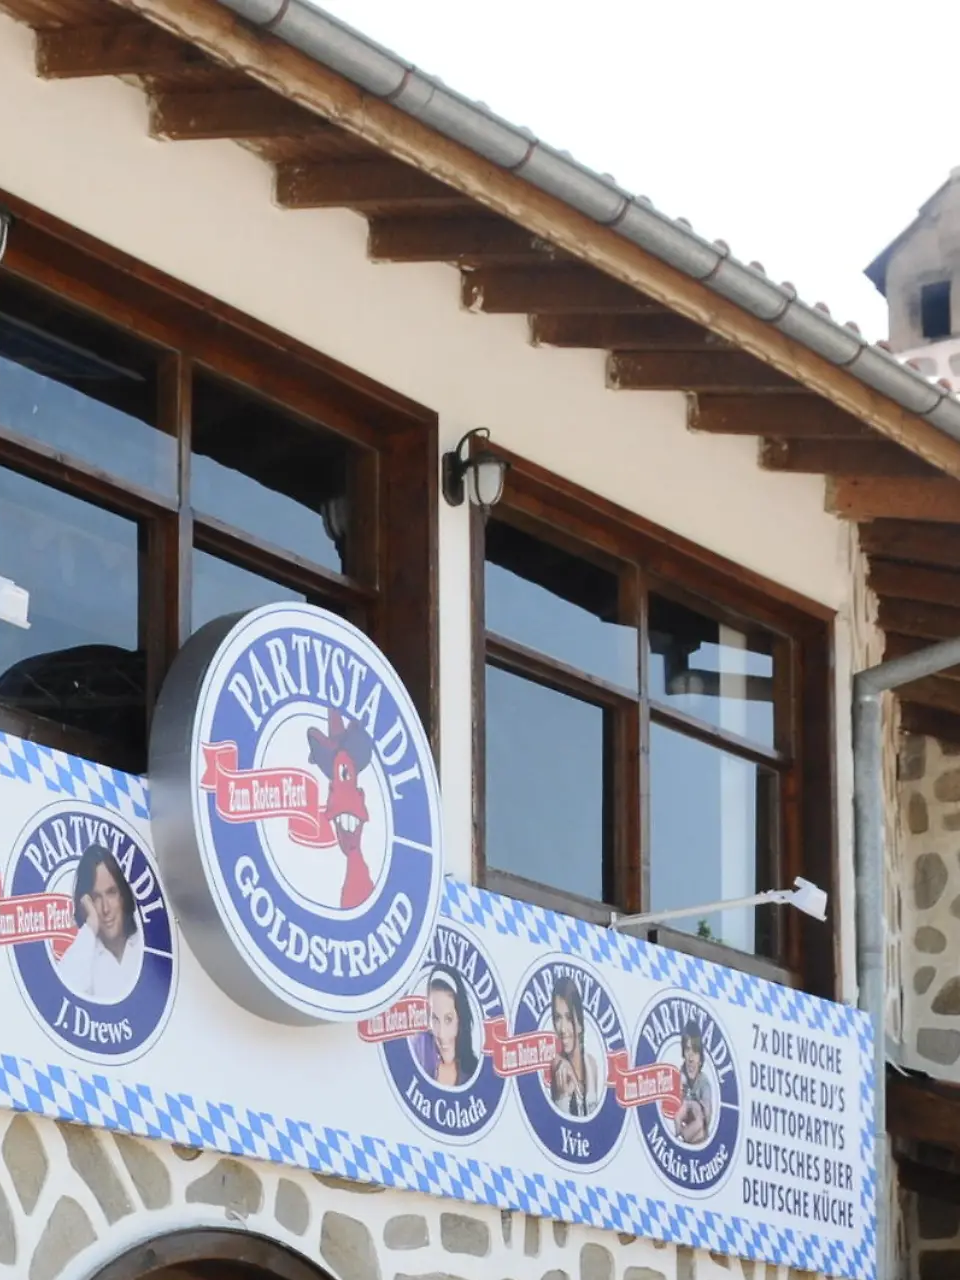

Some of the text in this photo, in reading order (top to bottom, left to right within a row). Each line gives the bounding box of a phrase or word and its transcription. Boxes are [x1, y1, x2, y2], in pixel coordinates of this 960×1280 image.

[227, 633, 423, 800] PARTYSTADL
[228, 774, 307, 810] Zum Roten Pferd
[16, 905, 46, 934] Roten
[46, 901, 70, 930] Pferd
[234, 855, 413, 978] GOLDSTRAND
[54, 997, 132, 1042] J. Drews
[752, 1023, 842, 1074] 7x DIE WOCHE
[405, 1075, 487, 1129] Ina Colada
[749, 1062, 845, 1113] DEUTSCHE DJ'S
[560, 1126, 590, 1158] Yvie
[750, 1100, 845, 1150] MOTTOPARTYS
[647, 1123, 729, 1184] Mickie Krause
[746, 1139, 853, 1190] DEUTSCHES BIER
[742, 1177, 854, 1228] DEUTSCHE KÜCHE
